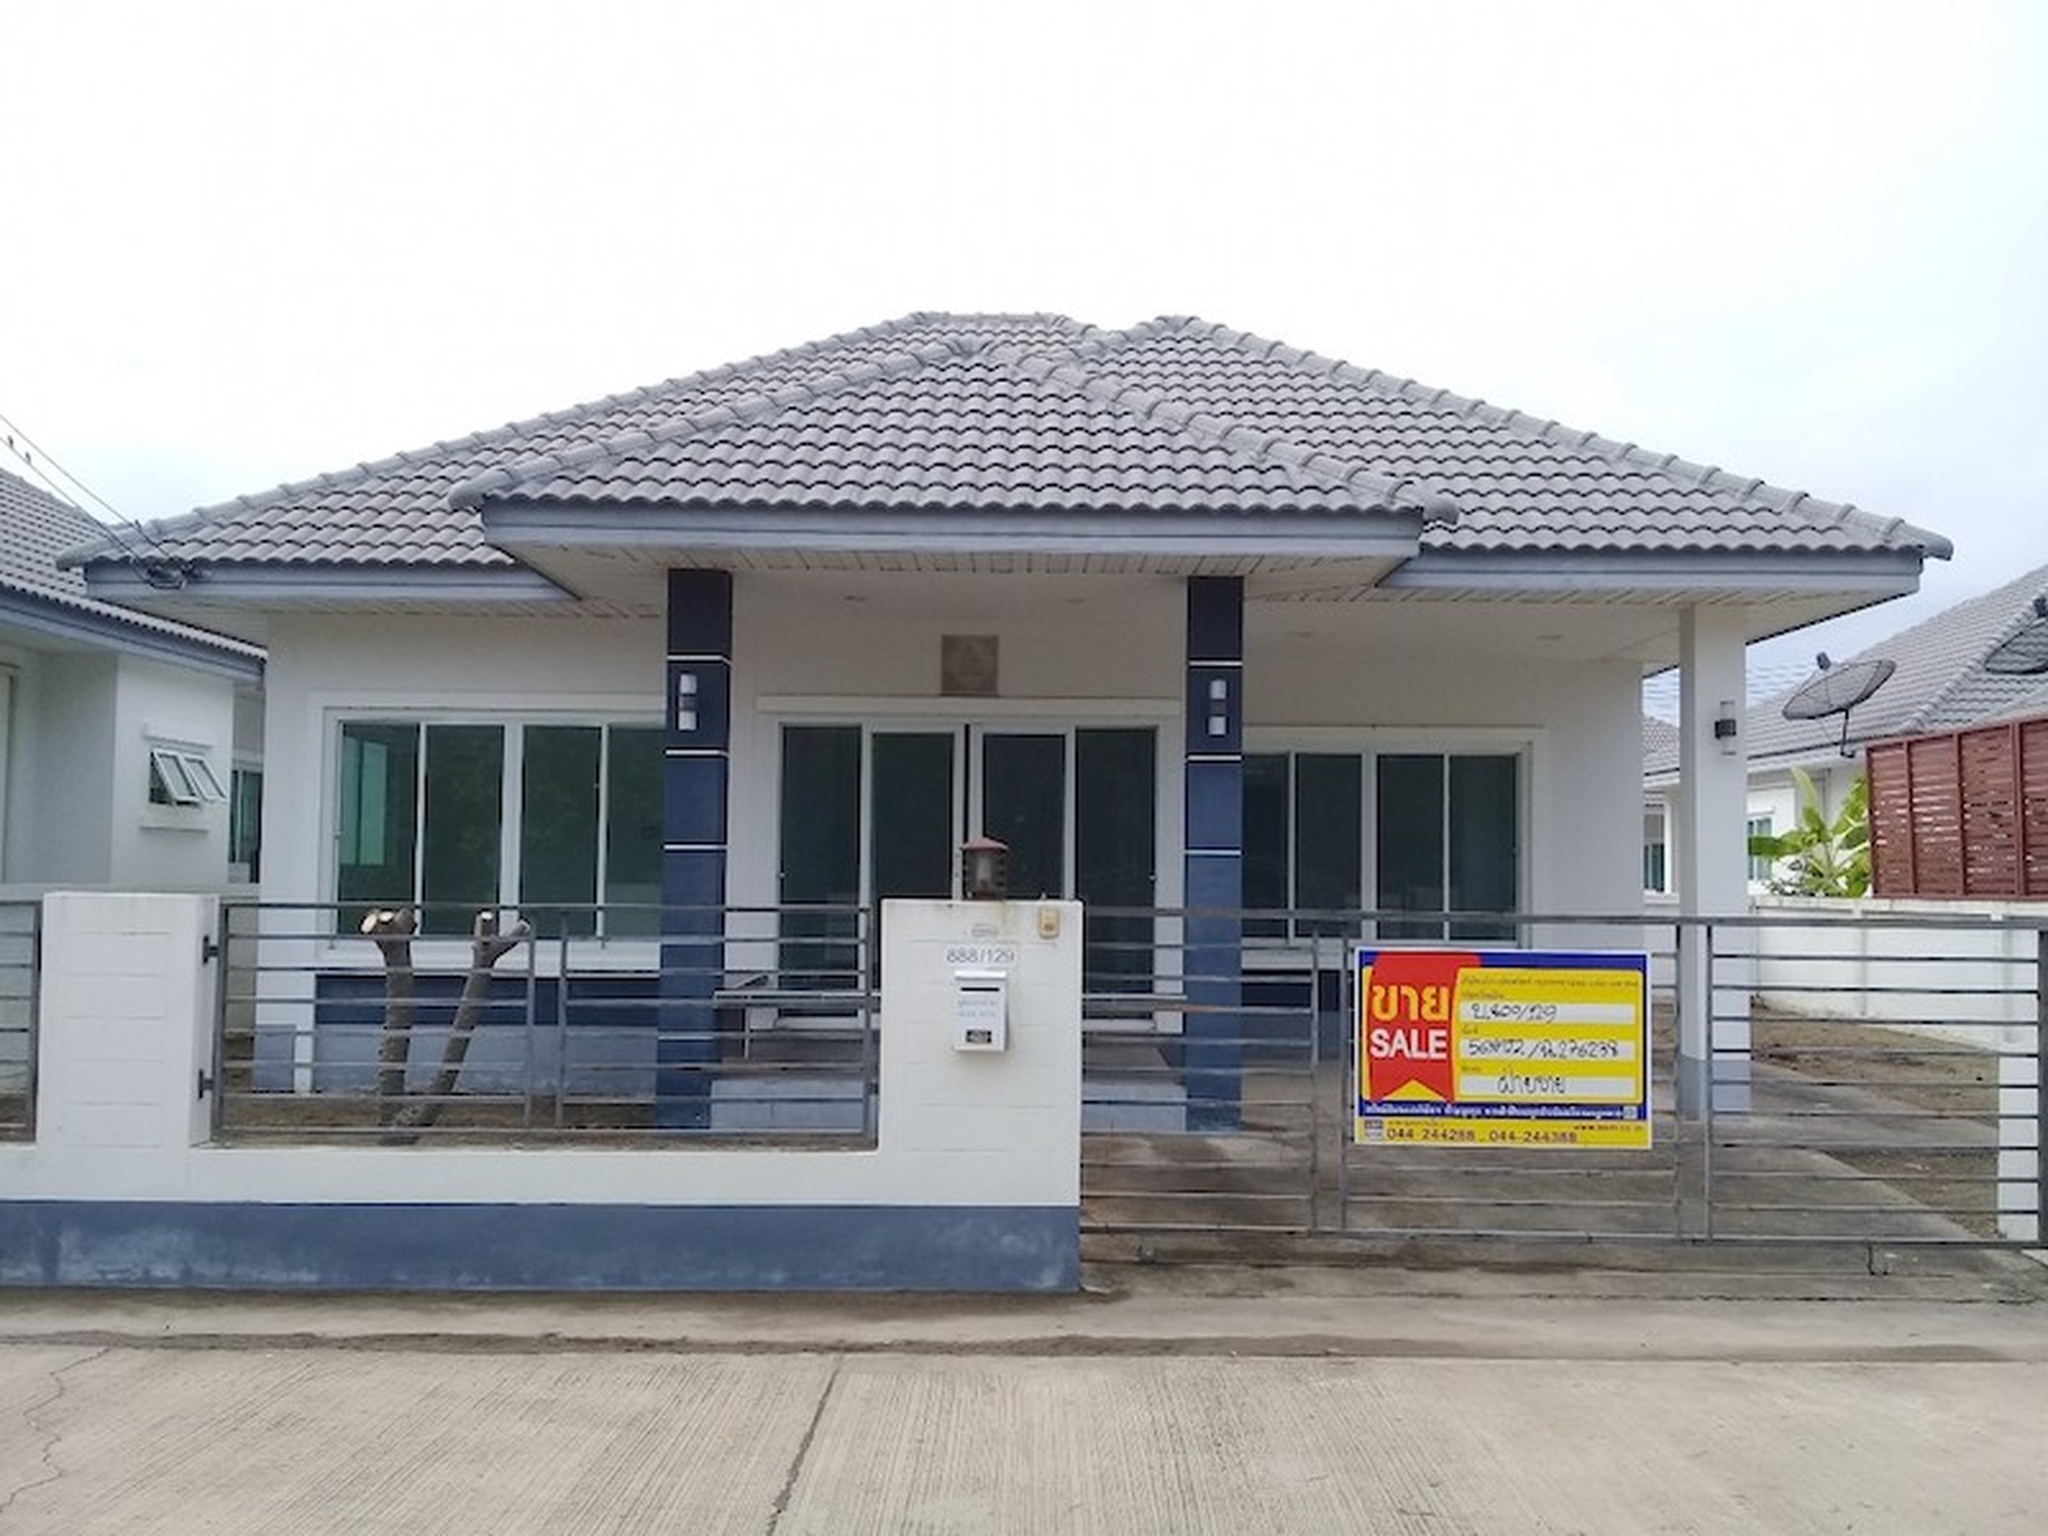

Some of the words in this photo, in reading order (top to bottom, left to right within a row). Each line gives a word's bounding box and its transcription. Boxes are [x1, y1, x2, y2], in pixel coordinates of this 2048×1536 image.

[946, 948, 1014, 964] 888/129
[1371, 984, 1449, 1021] ขาย
[1370, 1028, 1448, 1060] SALE
